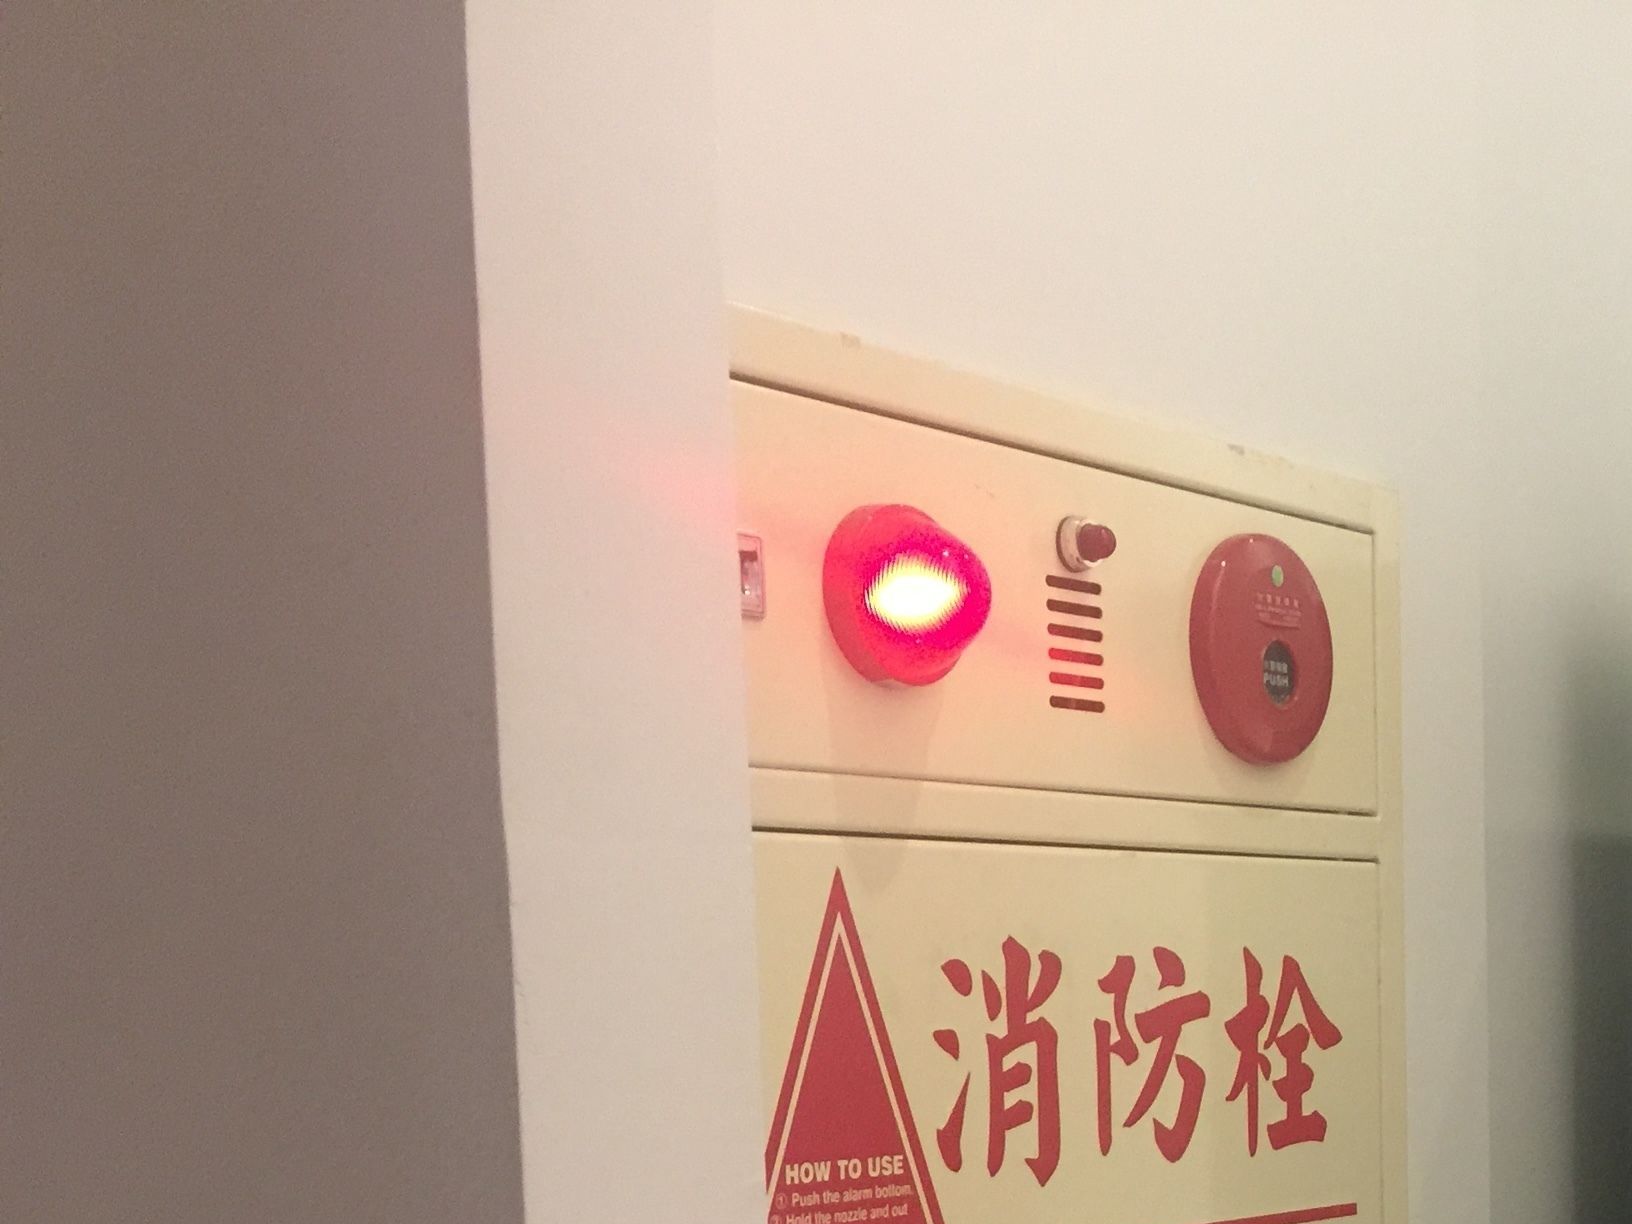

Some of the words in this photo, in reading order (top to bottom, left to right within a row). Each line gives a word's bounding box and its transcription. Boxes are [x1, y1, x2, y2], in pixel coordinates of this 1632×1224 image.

[933, 935, 1342, 1187] 消防栓
[785, 1160, 831, 1185] HOW
[838, 1158, 861, 1180] TO
[868, 1155, 904, 1177] USE
[792, 1191, 820, 1207] Push
[823, 1190, 840, 1204] the
[843, 1187, 872, 1201] alarm
[814, 1209, 831, 1224] the
[834, 1206, 867, 1223] nozzle
[870, 1204, 888, 1219] and
